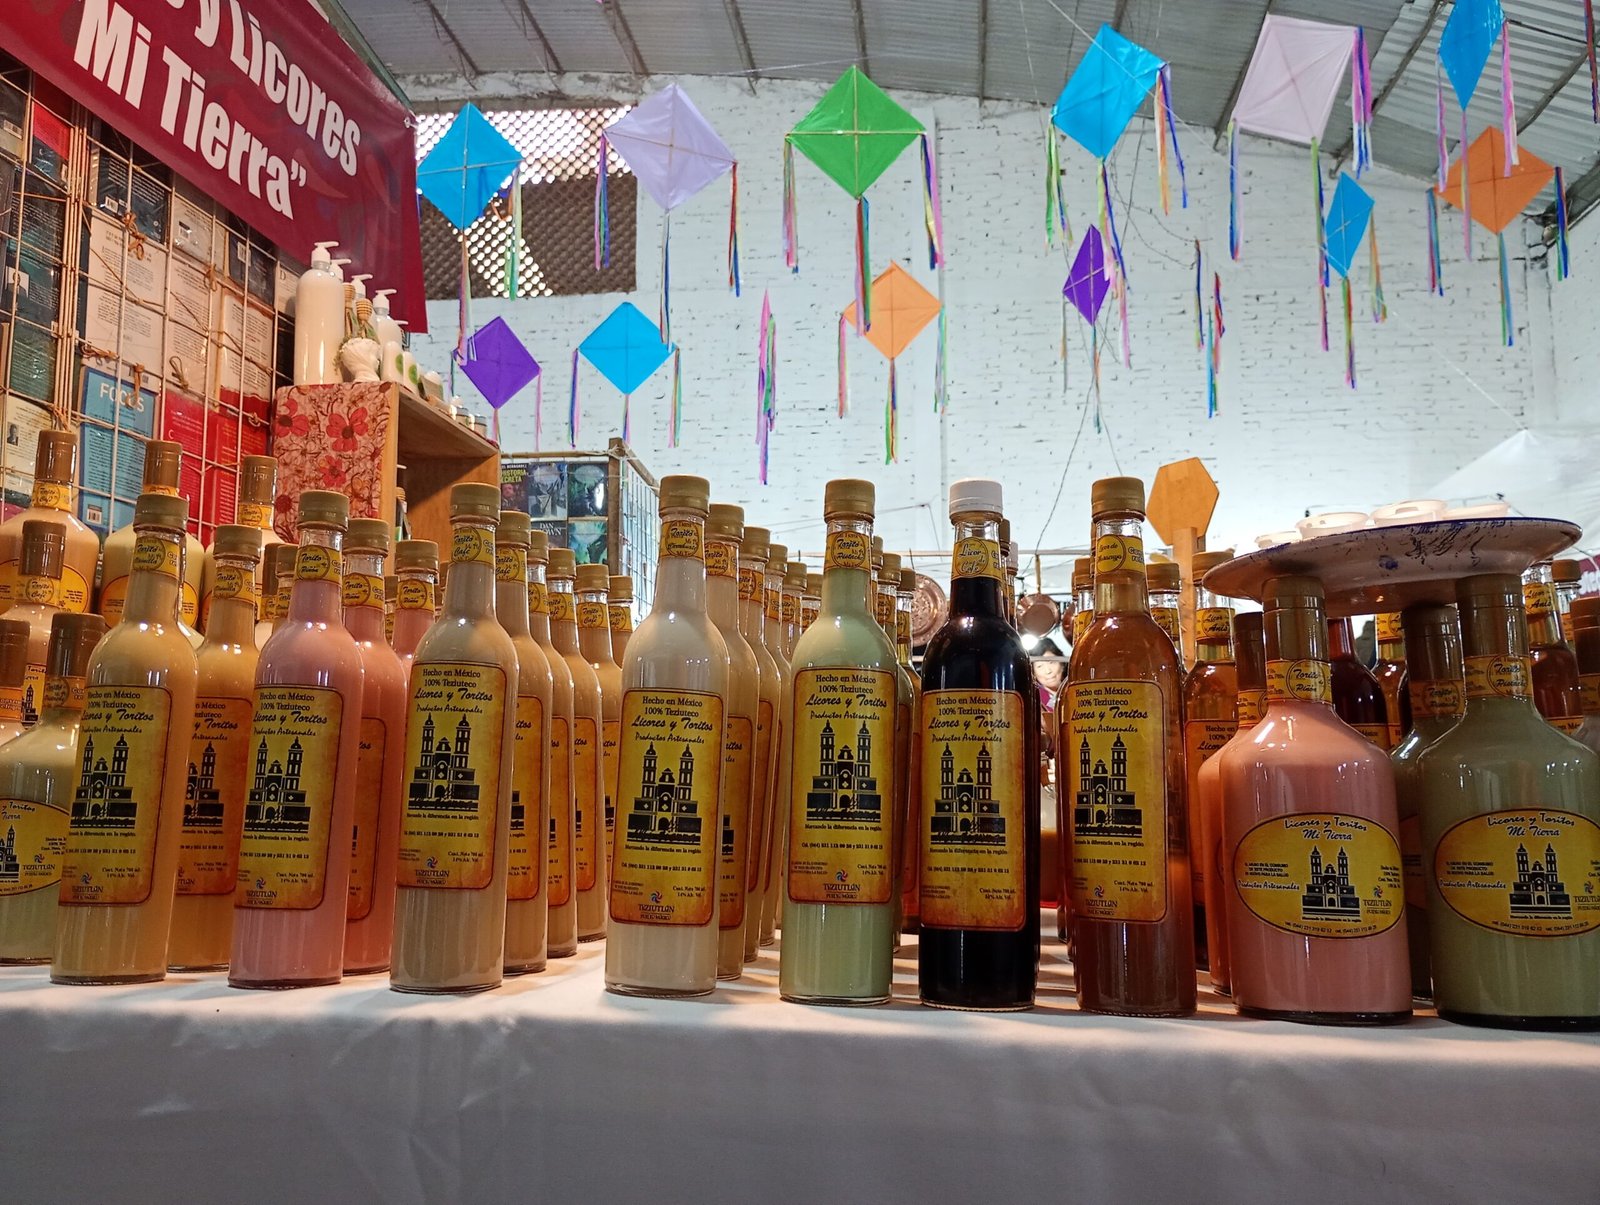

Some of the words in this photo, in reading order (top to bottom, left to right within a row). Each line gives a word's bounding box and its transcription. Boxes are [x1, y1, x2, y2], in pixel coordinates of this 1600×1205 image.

[73, 0, 152, 110] Mi
[230, 0, 360, 176] Licores
[100, 383, 144, 412] FOCUS
[671, 528, 694, 537] Torito
[837, 538, 860, 549] Torito
[960, 543, 981, 556] Licor
[302, 553, 322, 561] Torito
[961, 561, 979, 573] Café
[345, 581, 363, 589] Torito
[454, 669, 480, 678] México
[425, 679, 440, 687] 100%
[443, 679, 476, 688] Teziuteco
[852, 675, 876, 683] México
[414, 688, 443, 699] Licores
[447, 692, 453, 701] y
[458, 688, 493, 701] Toritos
[819, 685, 837, 693] 100%
[840, 685, 873, 694] Teziuteco
[1076, 689, 1092, 697] Hecho
[1104, 687, 1132, 695] México
[114, 691, 140, 699] México
[288, 693, 314, 701] México
[103, 701, 135, 709] Teziuteco
[643, 696, 664, 704] Hecho
[678, 698, 702, 707] México
[805, 694, 841, 706] Licores
[845, 699, 852, 708] y
[856, 694, 887, 707] Toritos
[936, 697, 956, 705] Hecho
[1093, 698, 1128, 706] Teziuteco
[276, 703, 310, 711] Teziuteco
[444, 704, 482, 713] Artesanales
[939, 707, 956, 715] 100%
[958, 707, 993, 715] Teziuteco
[106, 714, 112, 722] y
[116, 709, 154, 721] Toritos
[665, 708, 699, 717] Teziuteco
[810, 711, 842, 719] Productos
[844, 711, 880, 720] Artesanales
[1099, 712, 1105, 721] y
[1109, 706, 1148, 719] Toritos
[280, 715, 287, 725] y
[291, 711, 327, 724] Toritos
[632, 715, 666, 727] Licores
[670, 720, 677, 731] y
[681, 717, 713, 731] Toritos
[204, 718, 238, 730] Toritos
[928, 717, 959, 729] Licores
[964, 721, 970, 730] y
[1097, 724, 1138, 733] Artesanales
[277, 727, 316, 736] Artesanales
[668, 734, 705, 744] Artesanales
[1284, 819, 1320, 829] Licores
[1323, 821, 1331, 829] y
[1487, 816, 1525, 827] Licores
[1529, 817, 1536, 825] y
[1302, 829, 1320, 839] Mi
[1323, 829, 1353, 840] Tierra
[1507, 826, 1526, 836] Mi
[1529, 826, 1560, 837] Tierra
